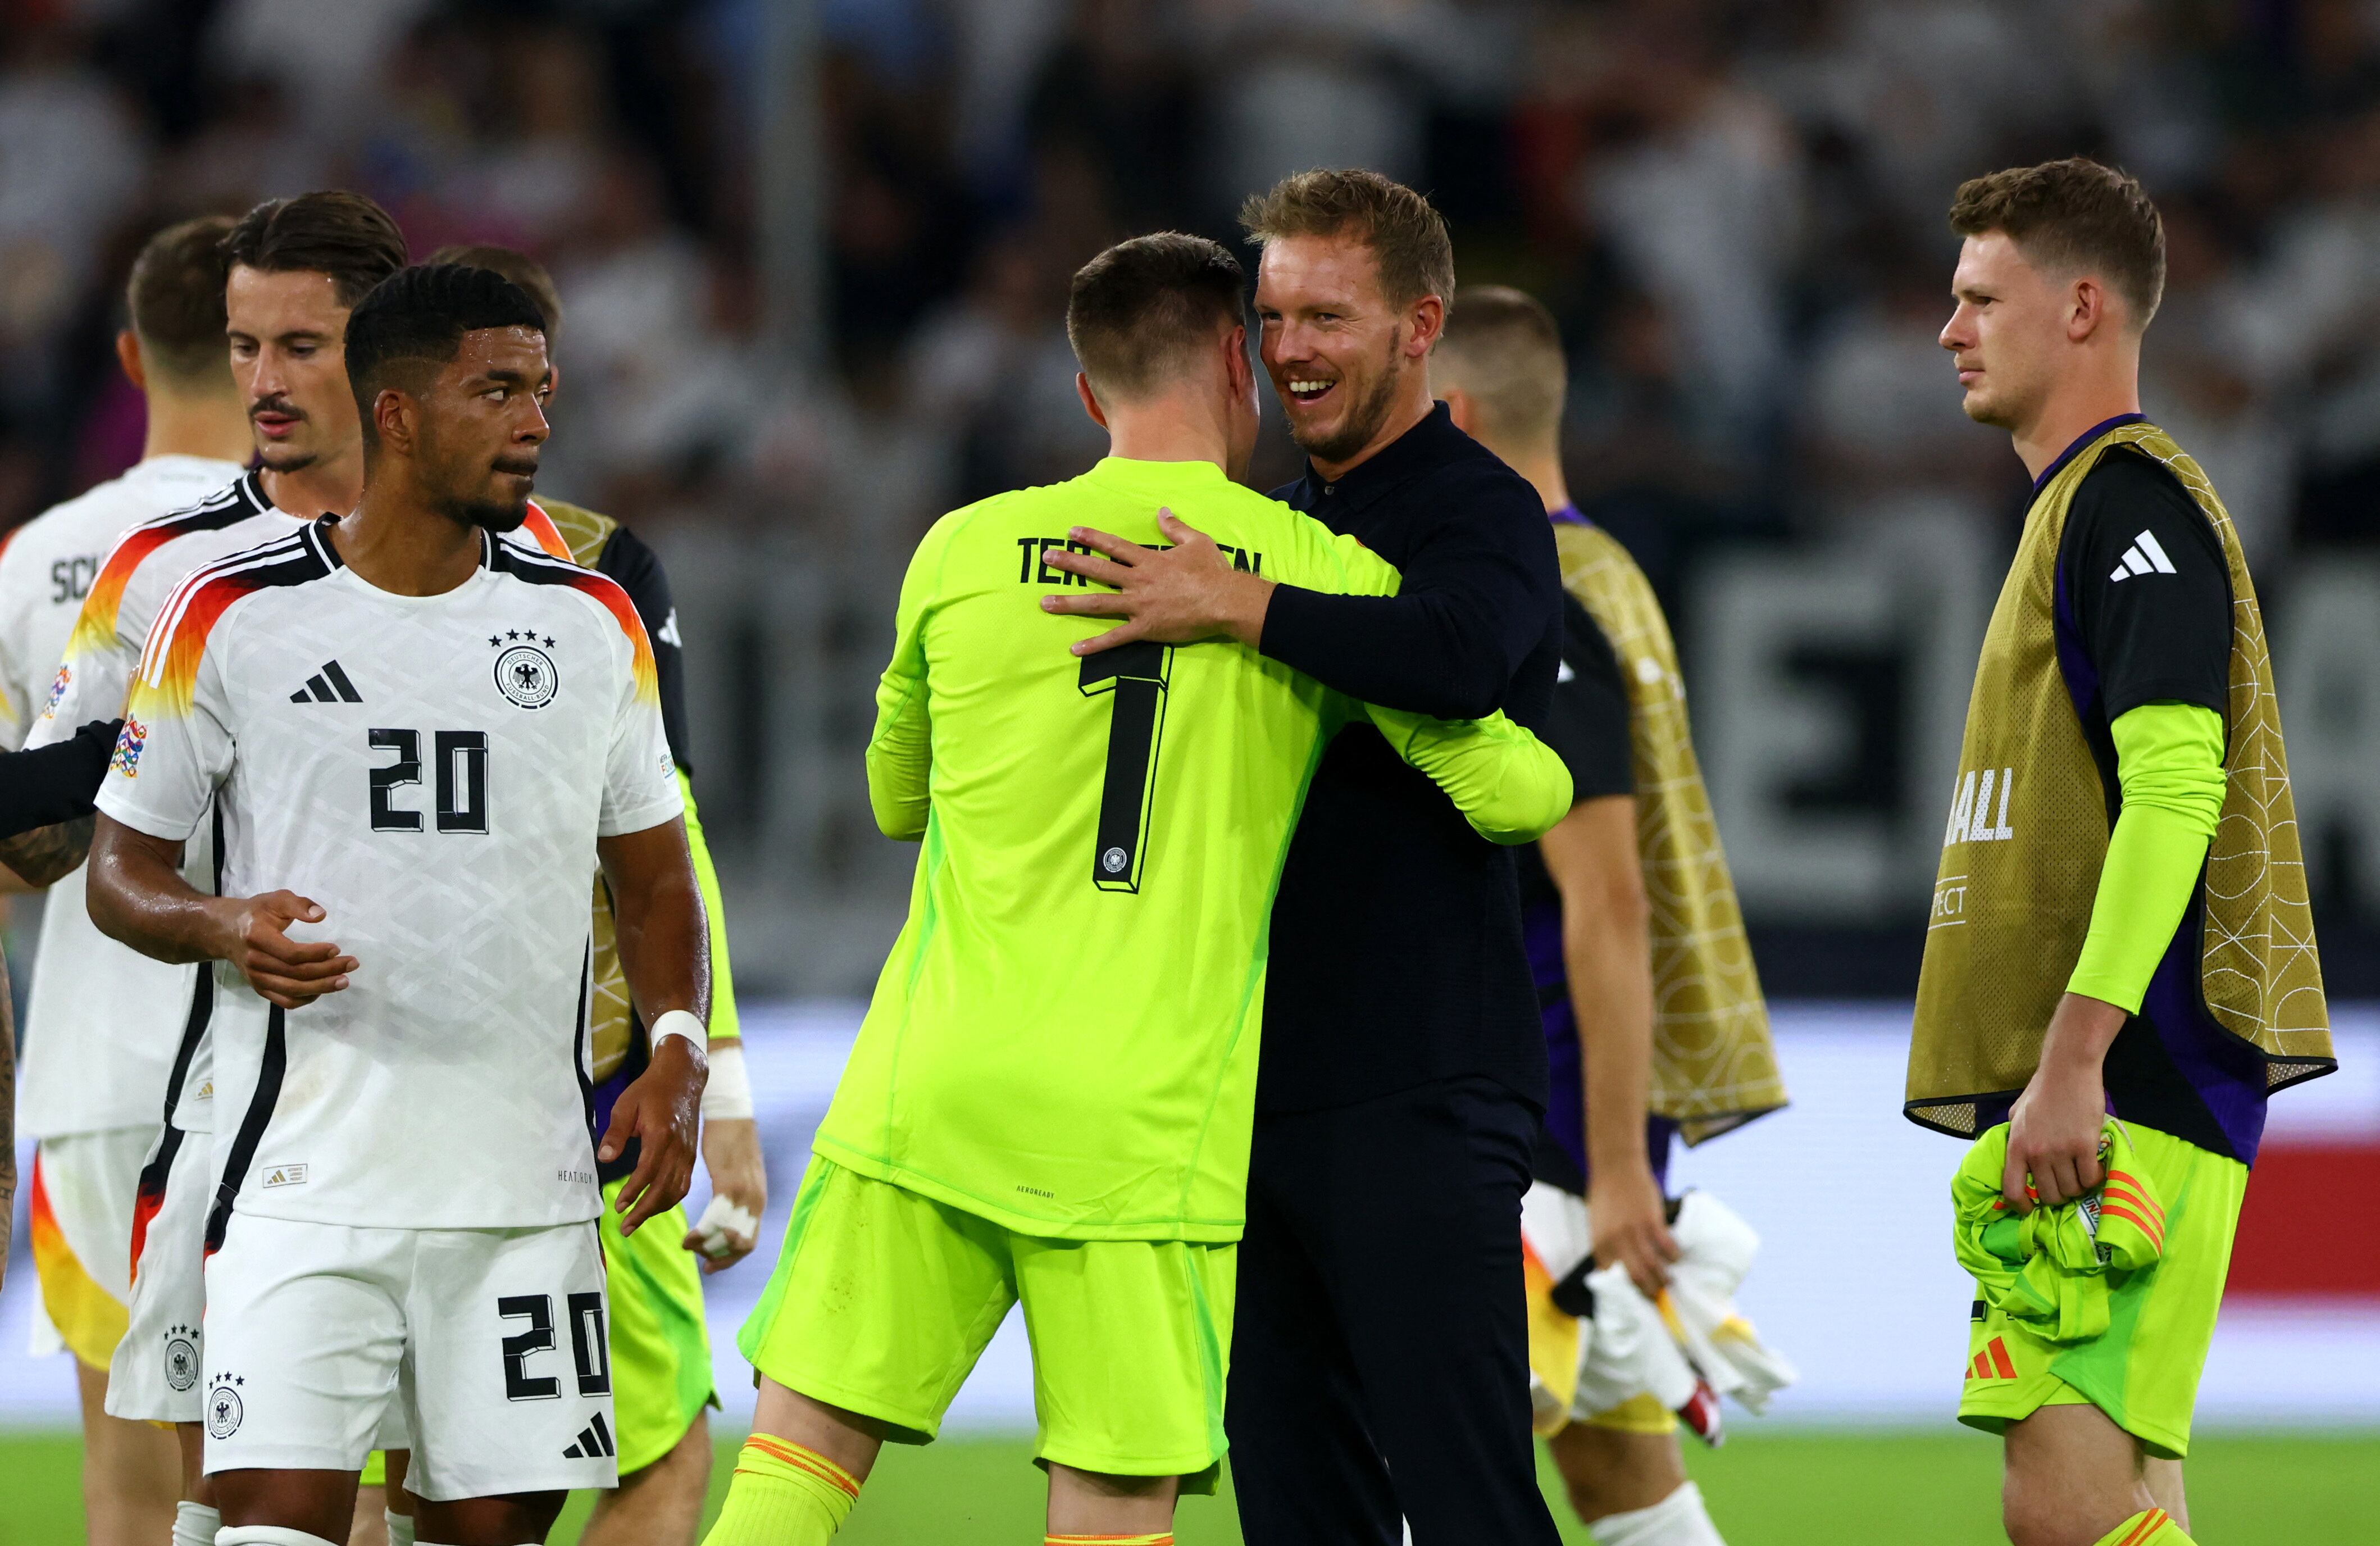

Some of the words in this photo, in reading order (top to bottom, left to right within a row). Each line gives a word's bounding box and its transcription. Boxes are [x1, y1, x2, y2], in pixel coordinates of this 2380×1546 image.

[1017, 538, 1091, 587] TER
[507, 654, 543, 666] DEUTSCHER
[506, 683, 549, 701] FUSSBALL-BUND
[368, 729, 489, 835] 20
[1078, 642, 1174, 894] 1
[558, 1170, 591, 1184] HEAT.RDY
[1016, 1185, 1054, 1199] AEROREADY
[498, 1292, 611, 1402] 20
